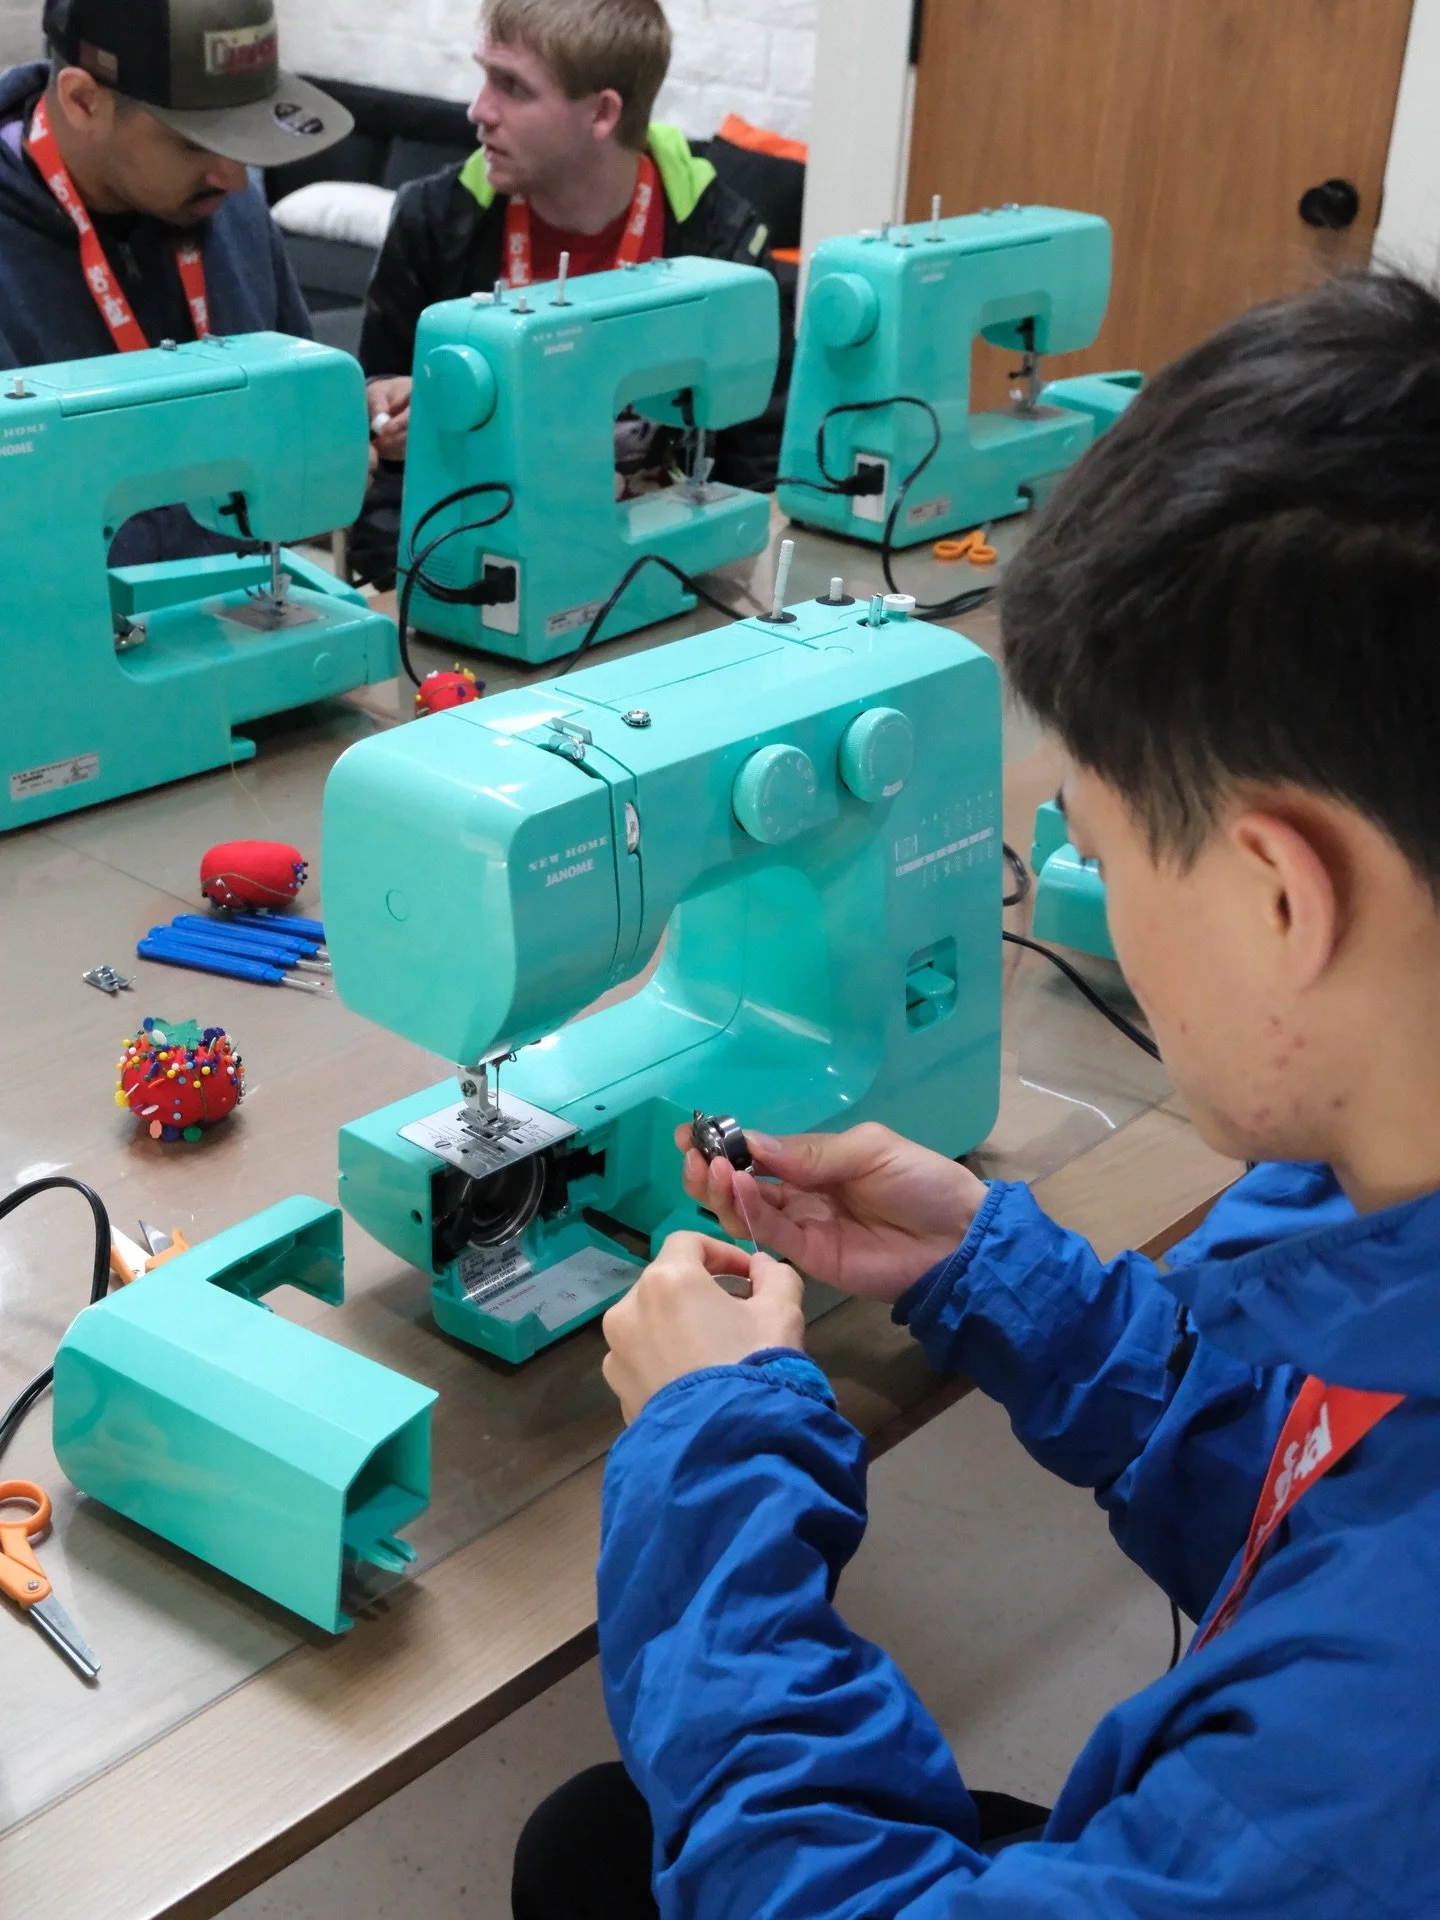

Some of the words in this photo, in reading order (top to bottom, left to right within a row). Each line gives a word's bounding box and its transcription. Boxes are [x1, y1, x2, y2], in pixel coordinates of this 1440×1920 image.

[528, 853, 560, 872] NEW
[565, 836, 608, 859] HOME
[544, 858, 595, 888] JANOME
